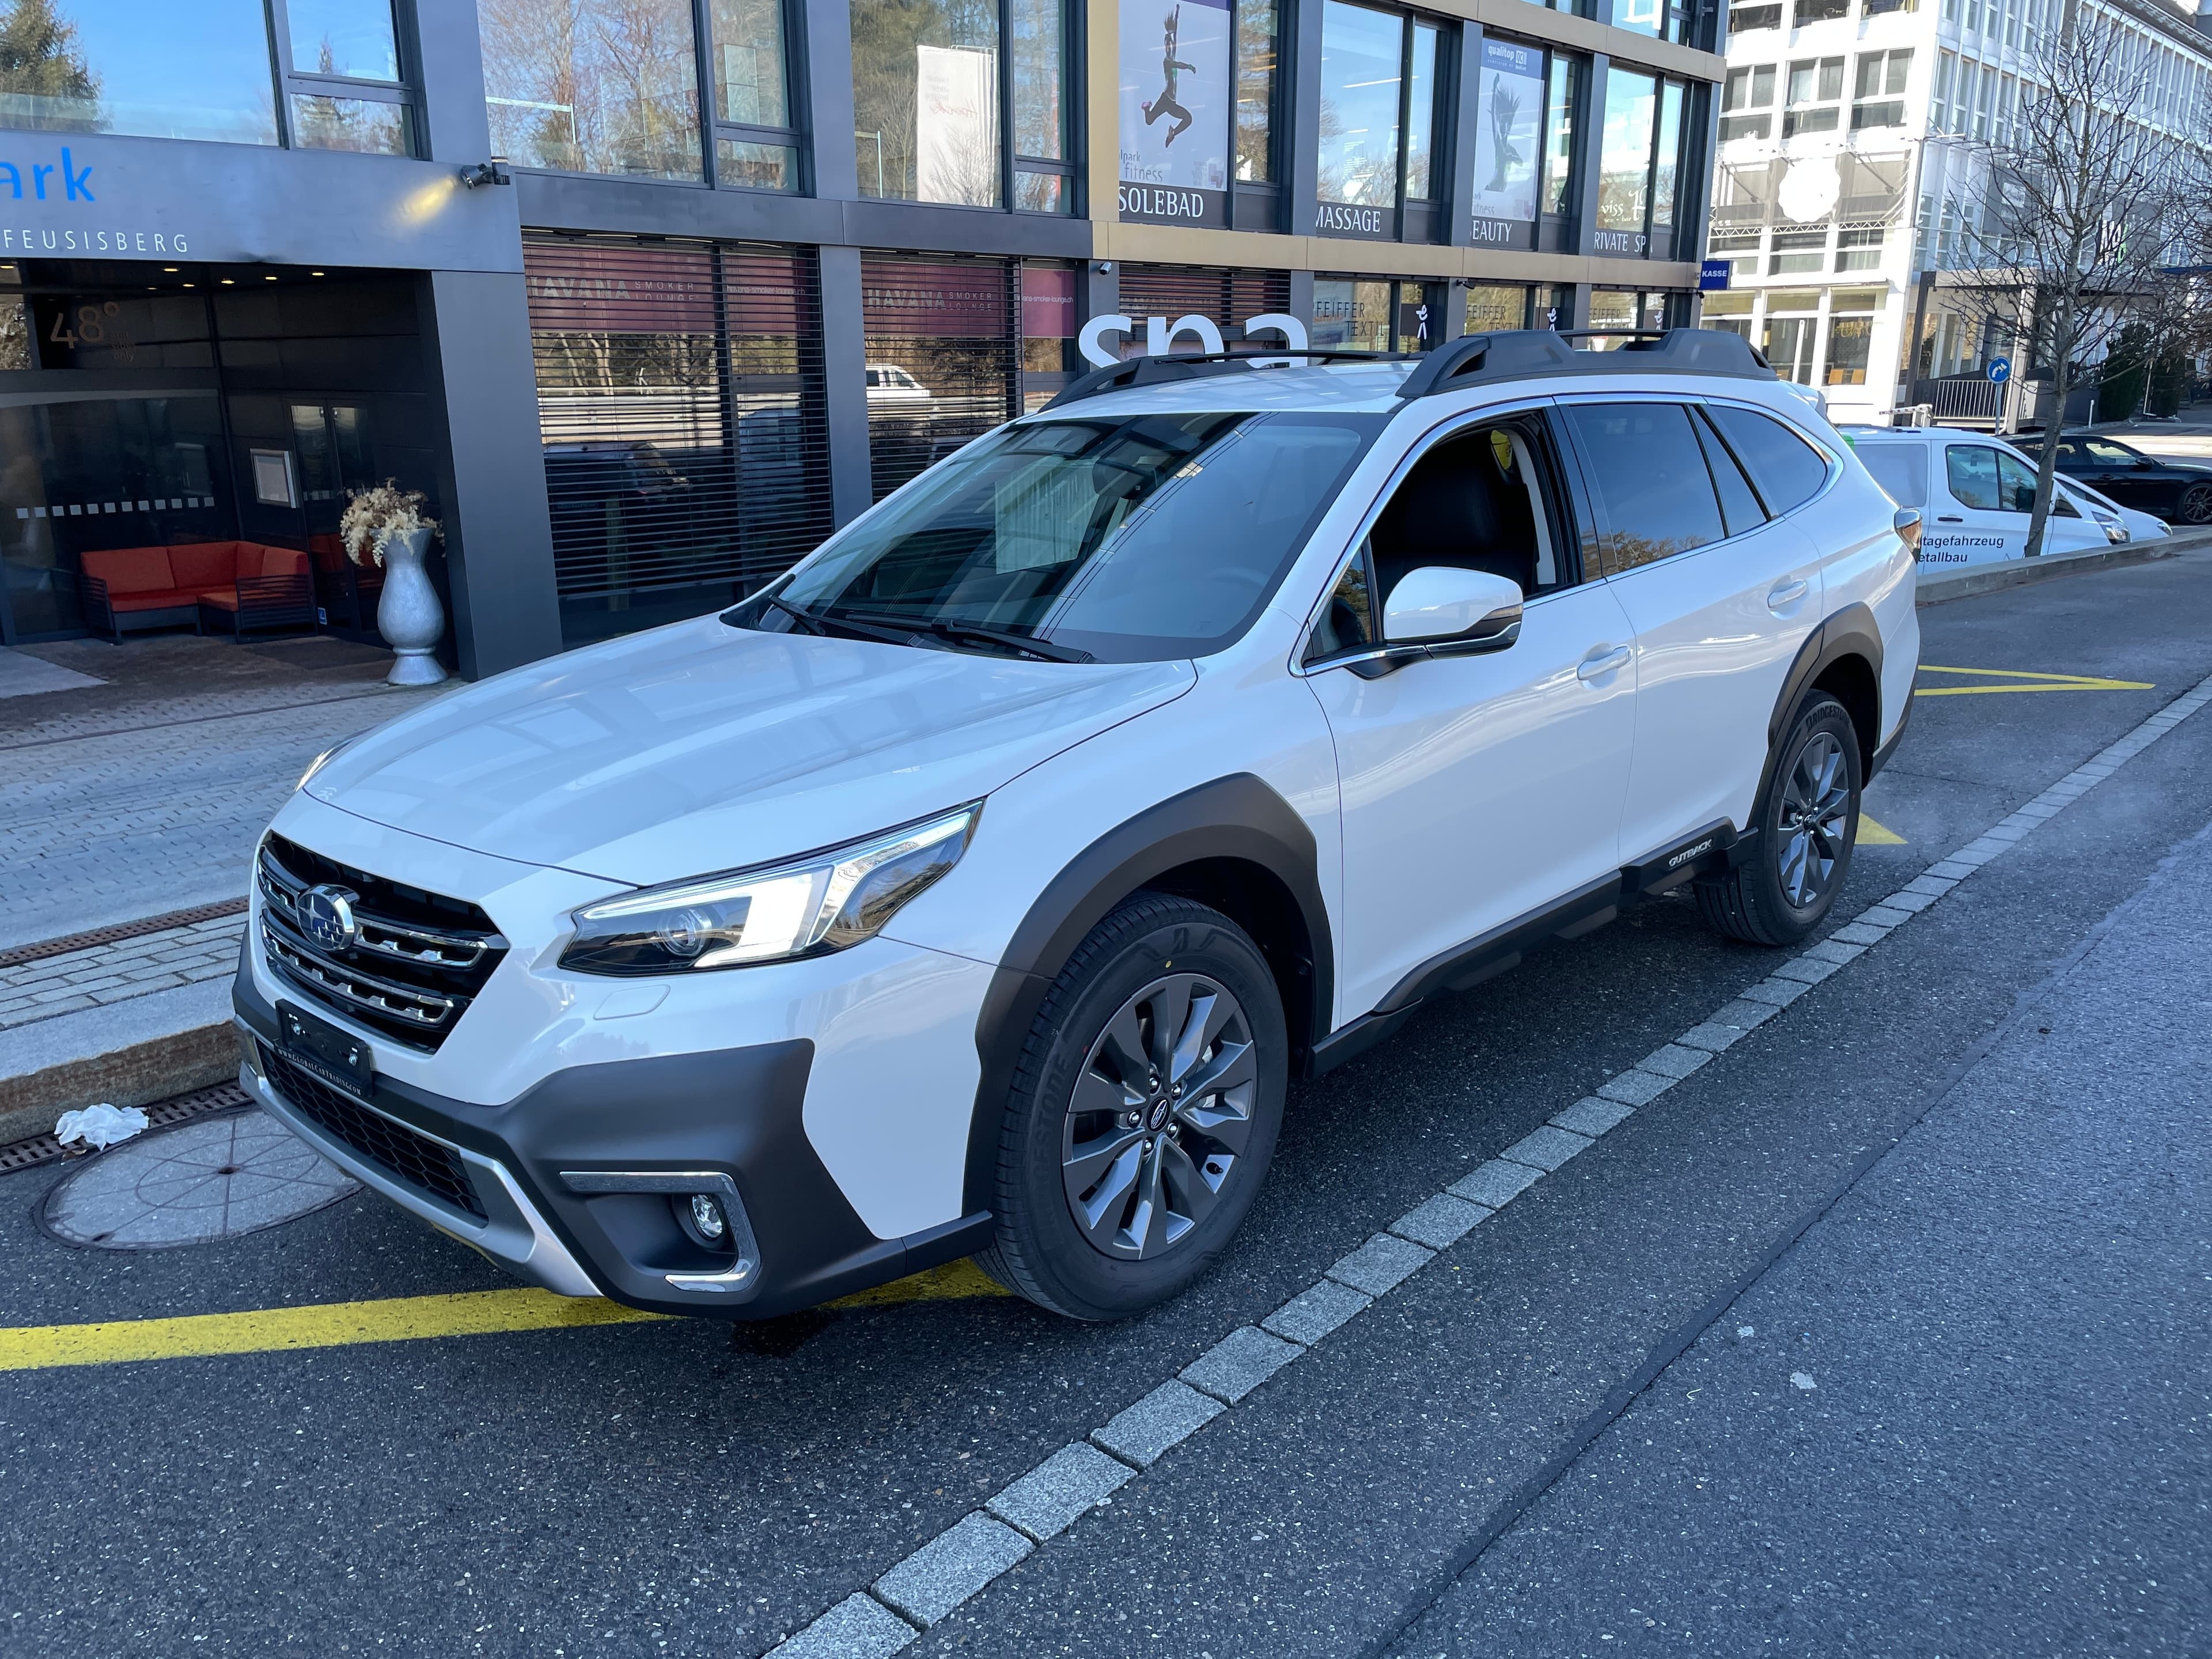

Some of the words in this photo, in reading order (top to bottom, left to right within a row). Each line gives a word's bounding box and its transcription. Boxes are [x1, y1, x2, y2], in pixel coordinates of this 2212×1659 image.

[1488, 46, 1514, 61] qualitop
[1119, 149, 1141, 164] lpark
[1124, 162, 1163, 182] fitness
[1119, 185, 1204, 218] SOLEBAD
[3, 229, 188, 253] FEUSISBERG
[1469, 219, 1513, 243] EAUTY
[1702, 270, 1728, 278] KASSE
[635, 280, 695, 291] SMOKER
[867, 289, 946, 310] HAVANA
[948, 291, 993, 300] SMOKER
[1313, 301, 1365, 318] FEIFFER
[1668, 838, 1713, 867] OUTBACK
